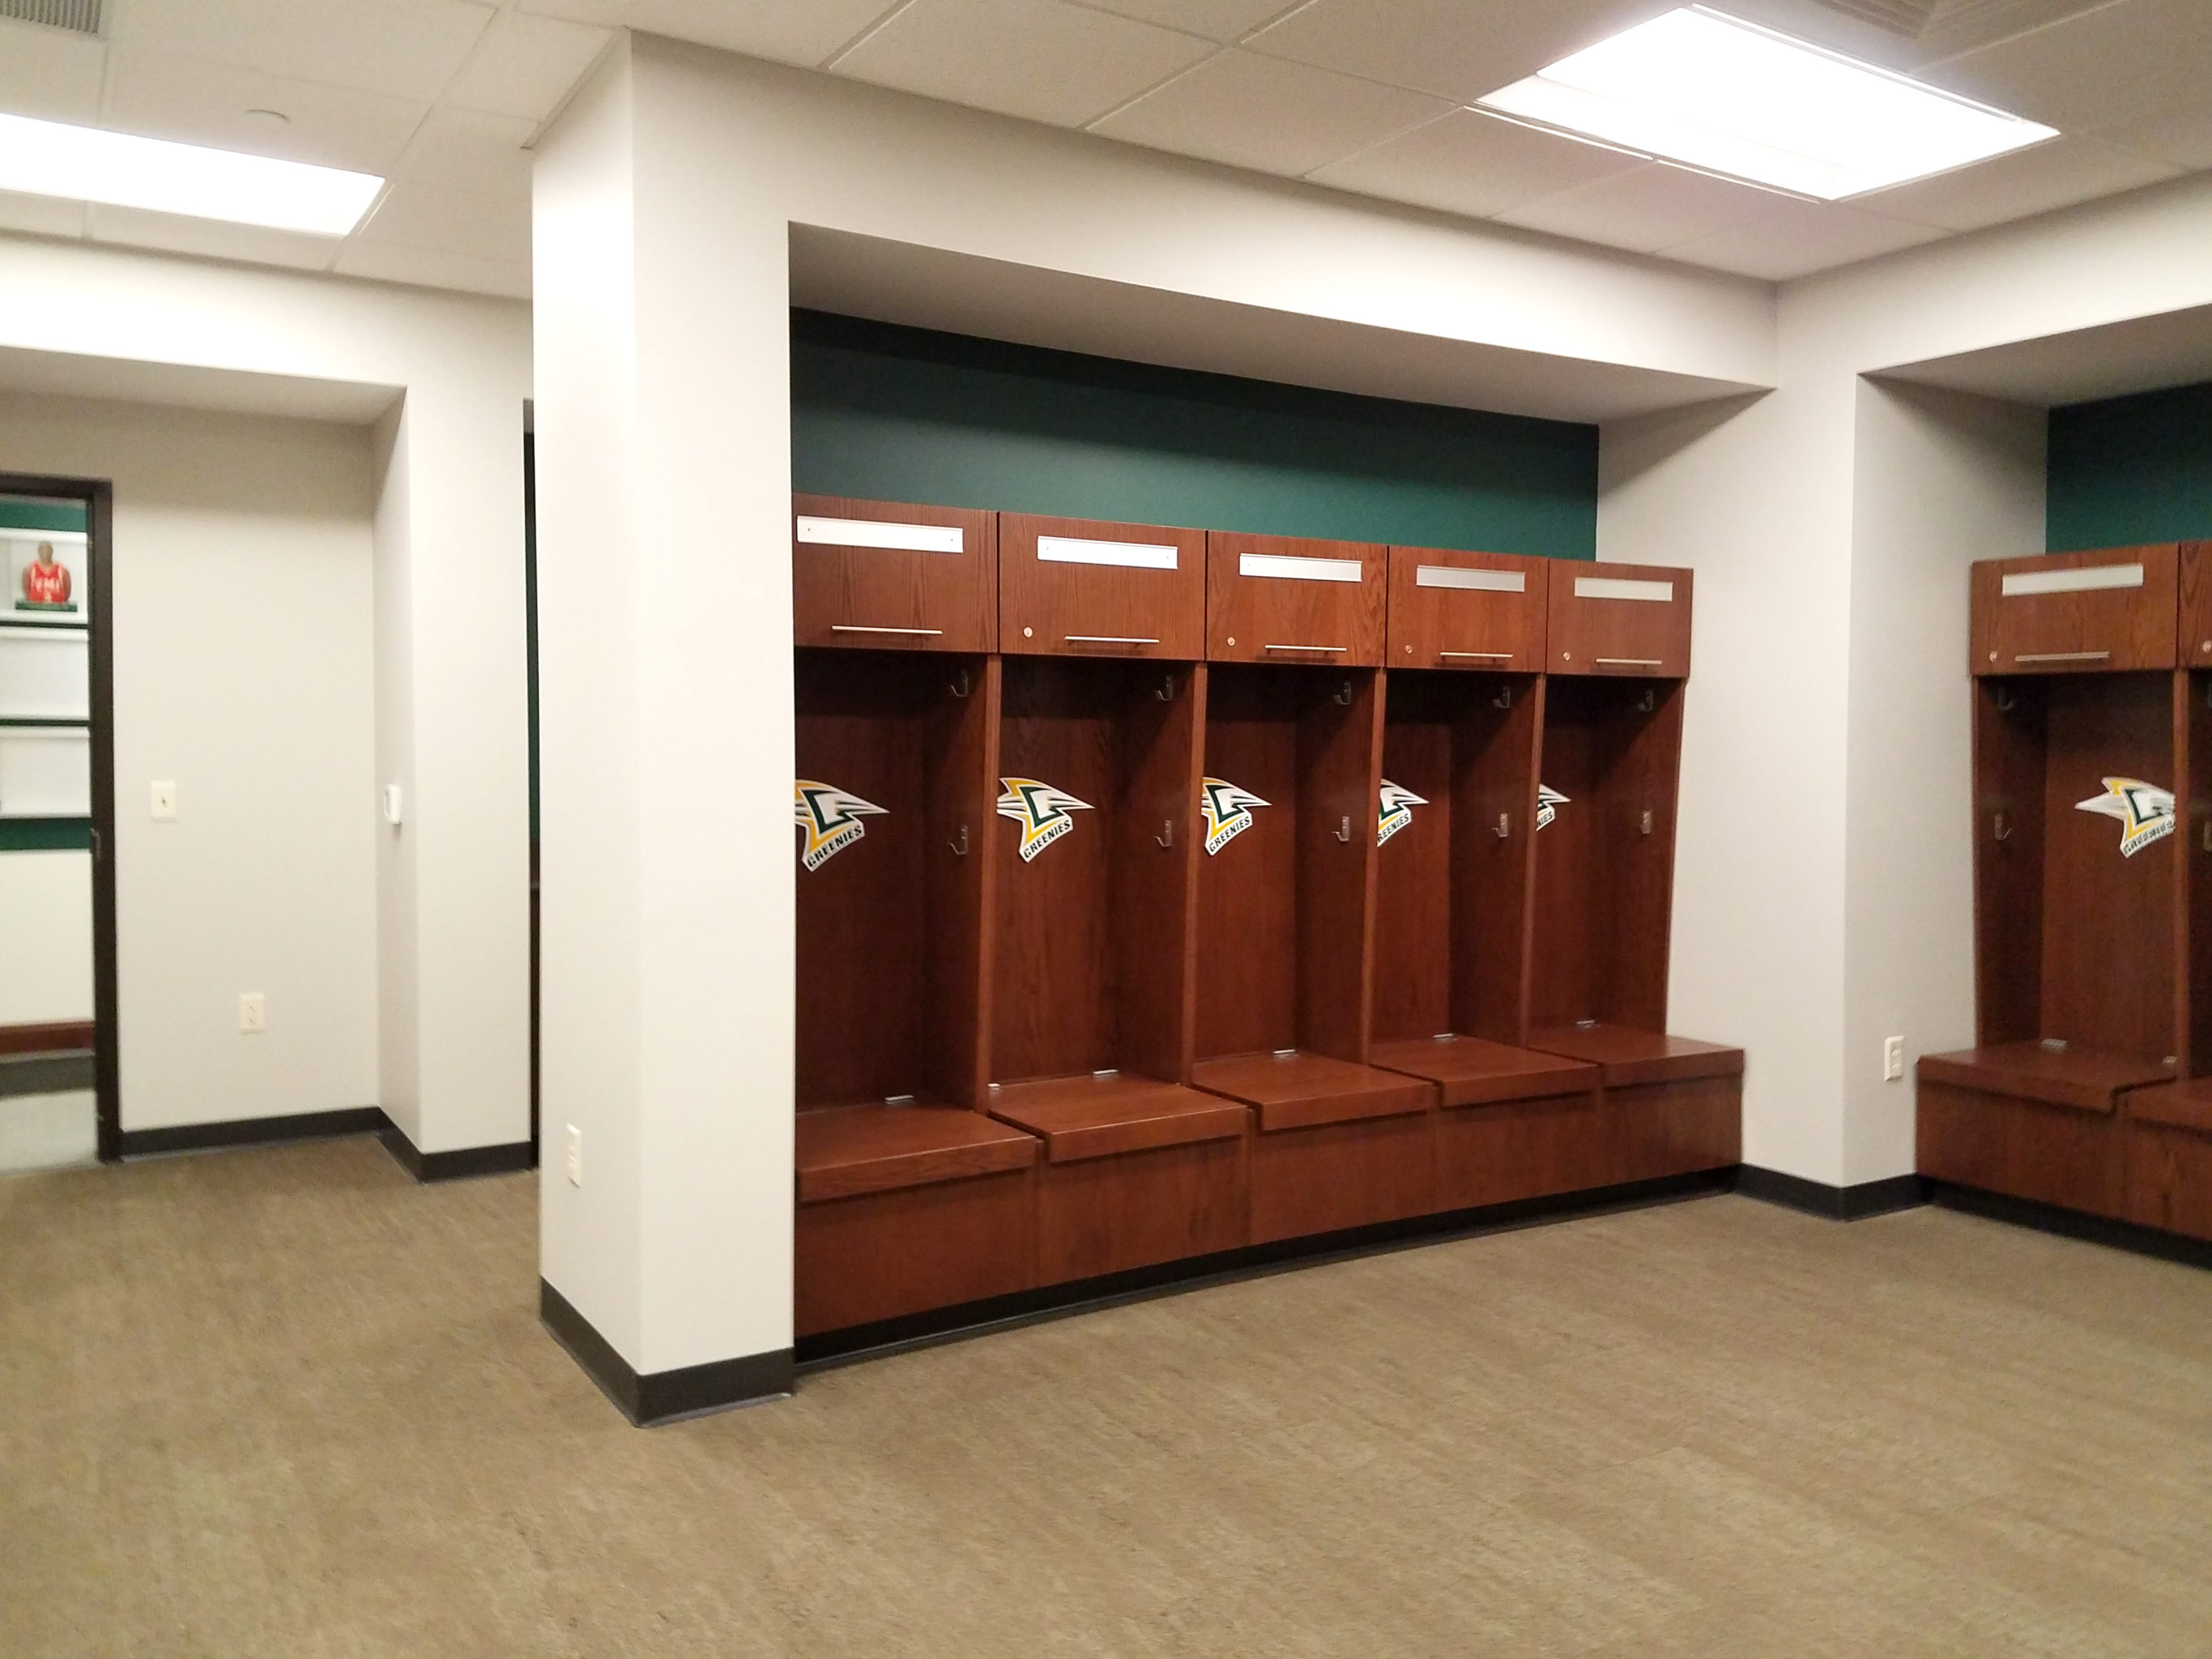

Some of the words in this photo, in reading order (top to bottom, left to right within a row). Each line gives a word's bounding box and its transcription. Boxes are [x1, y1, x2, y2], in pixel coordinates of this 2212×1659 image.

[808, 824, 863, 867] GREENIES
[1023, 821, 1070, 858] GREENIES
[1209, 817, 1251, 852] GREENIES
